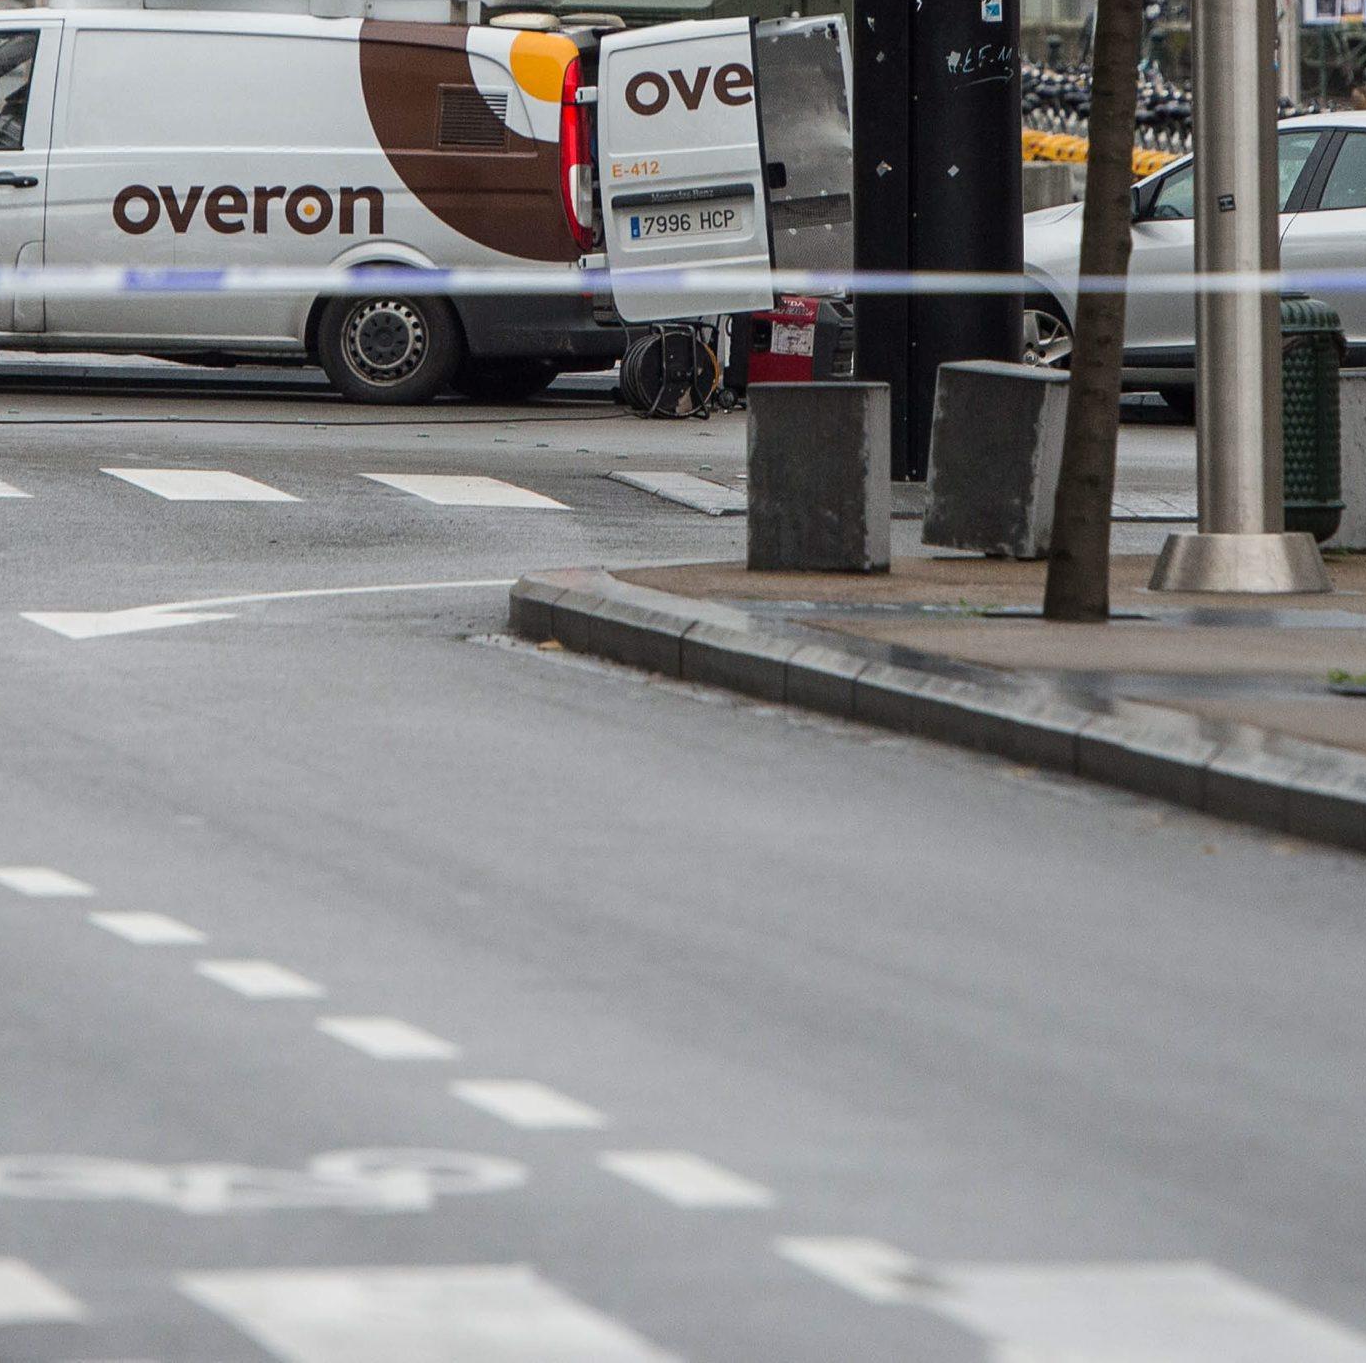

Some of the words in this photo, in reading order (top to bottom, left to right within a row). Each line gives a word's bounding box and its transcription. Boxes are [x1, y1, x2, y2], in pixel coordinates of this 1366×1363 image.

[625, 63, 754, 116] ove
[612, 161, 661, 178] E-412
[112, 185, 384, 235] overon
[645, 213, 691, 235] 7996
[700, 209, 735, 230] HCP
